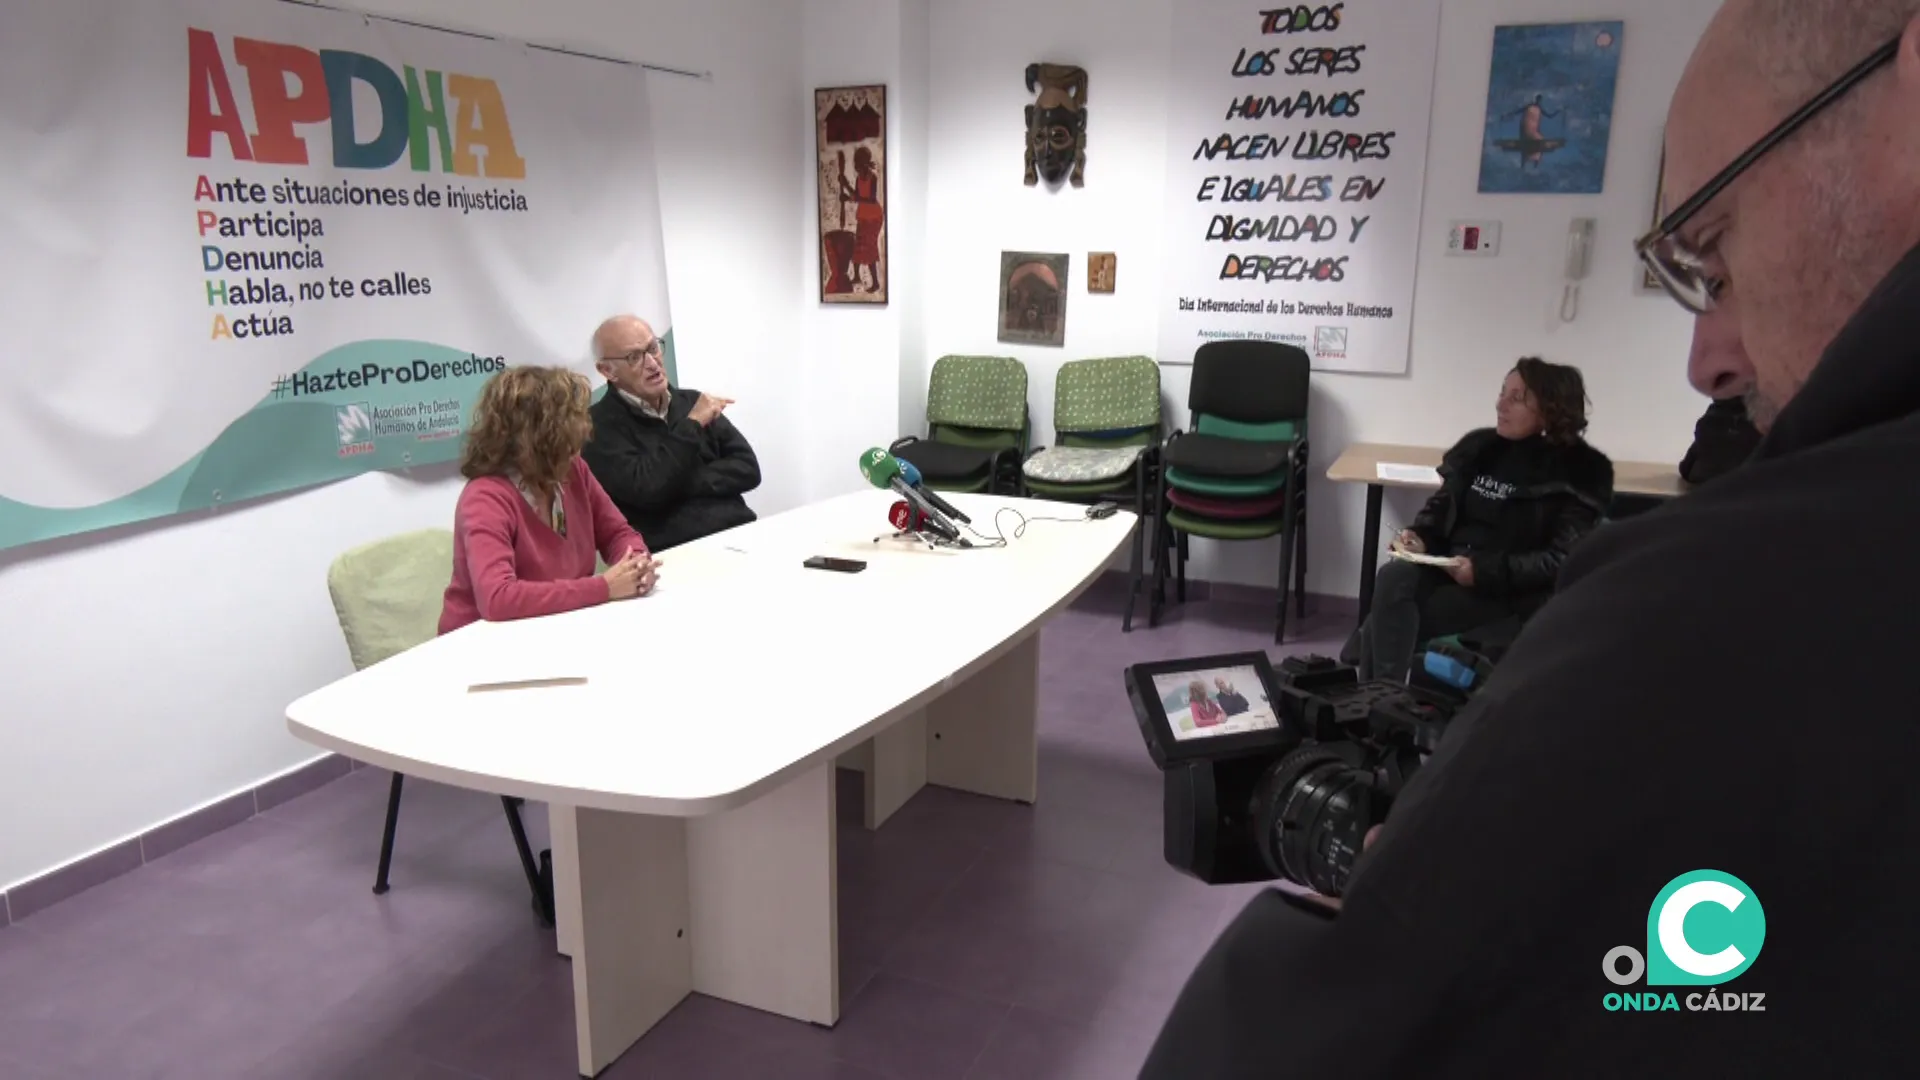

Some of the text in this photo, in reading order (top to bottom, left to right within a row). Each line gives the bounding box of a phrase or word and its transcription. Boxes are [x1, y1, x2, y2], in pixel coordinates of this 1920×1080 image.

[1259, 2, 1344, 34] TODOS
[1231, 44, 1366, 77] LOS SERES
[187, 27, 526, 180] APDHA
[1225, 89, 1365, 120] HUMANOS
[1193, 130, 1396, 162] NACEN LIBRES
[194, 175, 528, 214] Ante situaciones de injusticia
[1197, 173, 1386, 202] E IGUALES EN
[196, 210, 324, 243] Participa
[1205, 214, 1371, 243] DIGNIDAD Y
[202, 243, 324, 273] Denuncia
[1219, 253, 1349, 284] DERECHOS
[206, 271, 431, 308] Habla, no te calles
[1197, 298, 1264, 315] Internacional
[1266, 300, 1278, 314] de
[1280, 300, 1295, 315] los
[1298, 301, 1344, 317] Derechos
[1346, 303, 1393, 319] Humanos
[211, 309, 294, 340] Actúa
[271, 353, 506, 399] #HazteProDerechos
[373, 405, 417, 420] Asociación
[418, 402, 432, 415] Pro
[374, 422, 416, 435] Humanos
[417, 418, 428, 429] de
